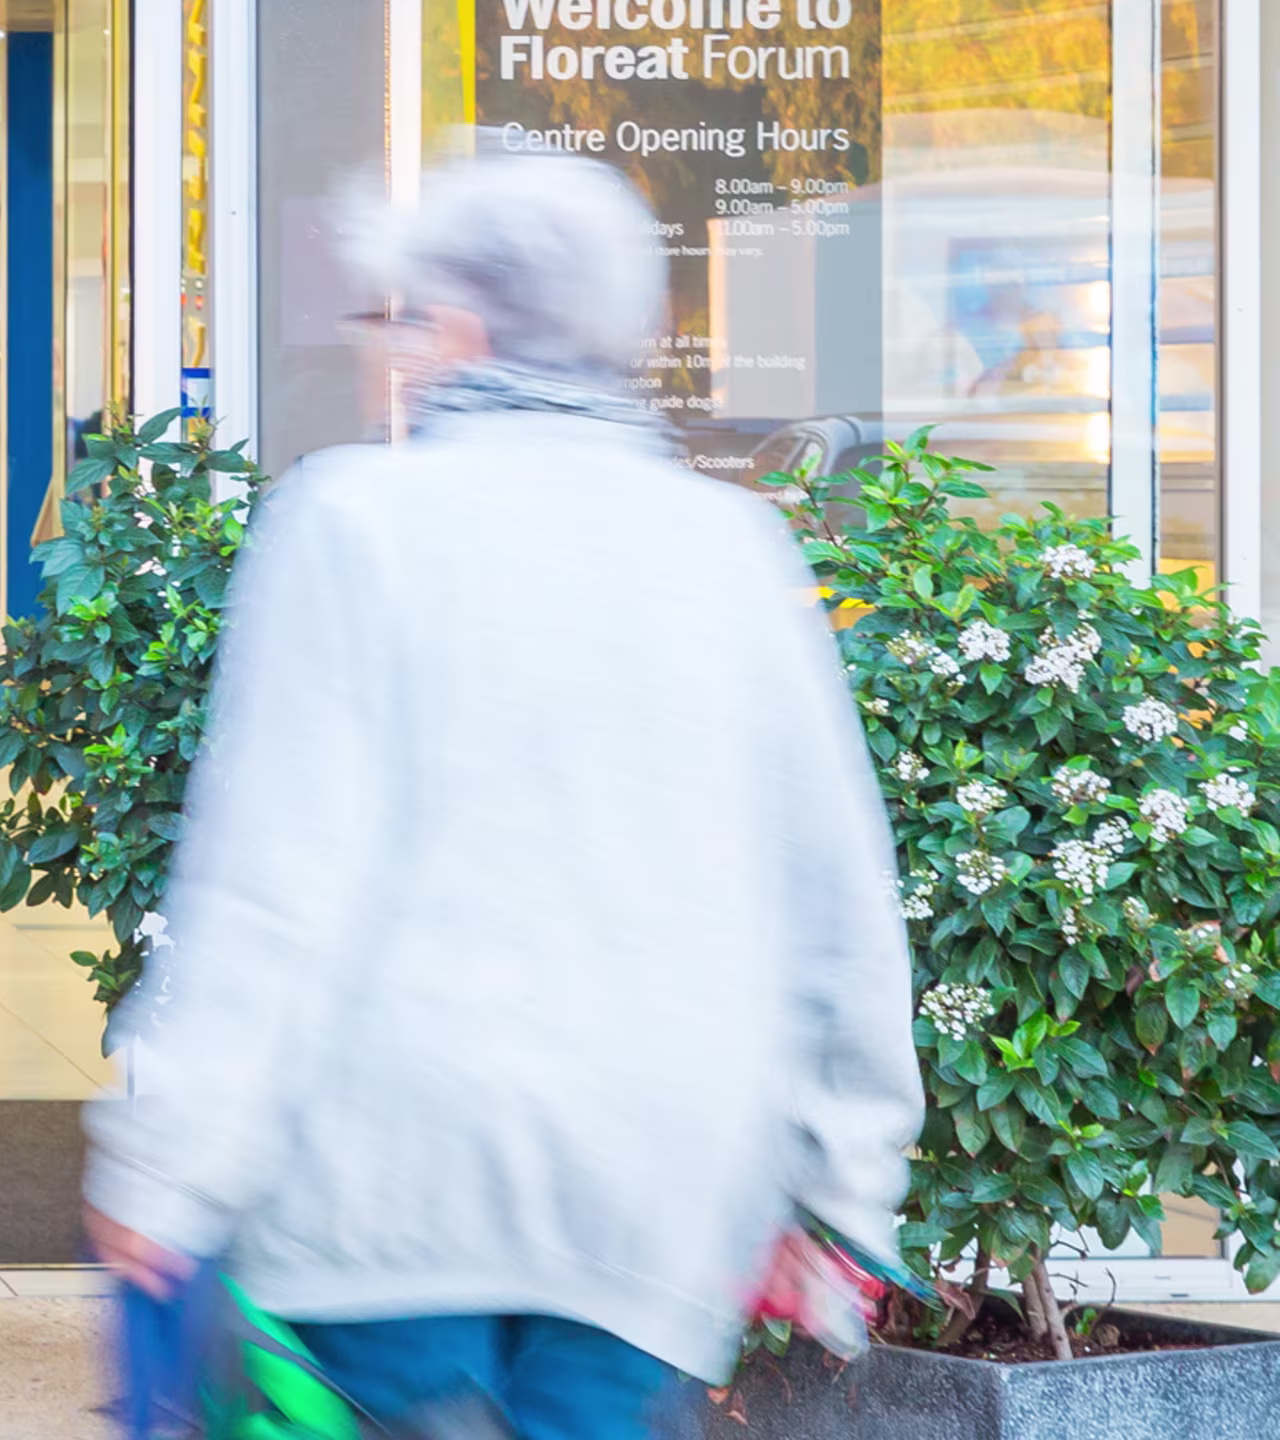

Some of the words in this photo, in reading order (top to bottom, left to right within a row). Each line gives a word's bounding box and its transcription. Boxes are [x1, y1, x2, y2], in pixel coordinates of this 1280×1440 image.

[500, 34, 690, 80] Floreat
[703, 34, 850, 79] Forum
[501, 122, 605, 153] Centre
[615, 120, 746, 157] Opening
[756, 122, 850, 153] Hours
[714, 178, 774, 195] 8.00am
[790, 178, 849, 196] 9.00pm
[714, 199, 774, 215] 9.00am
[790, 199, 849, 216] 5.00pm
[791, 220, 851, 239] 5.00pm
